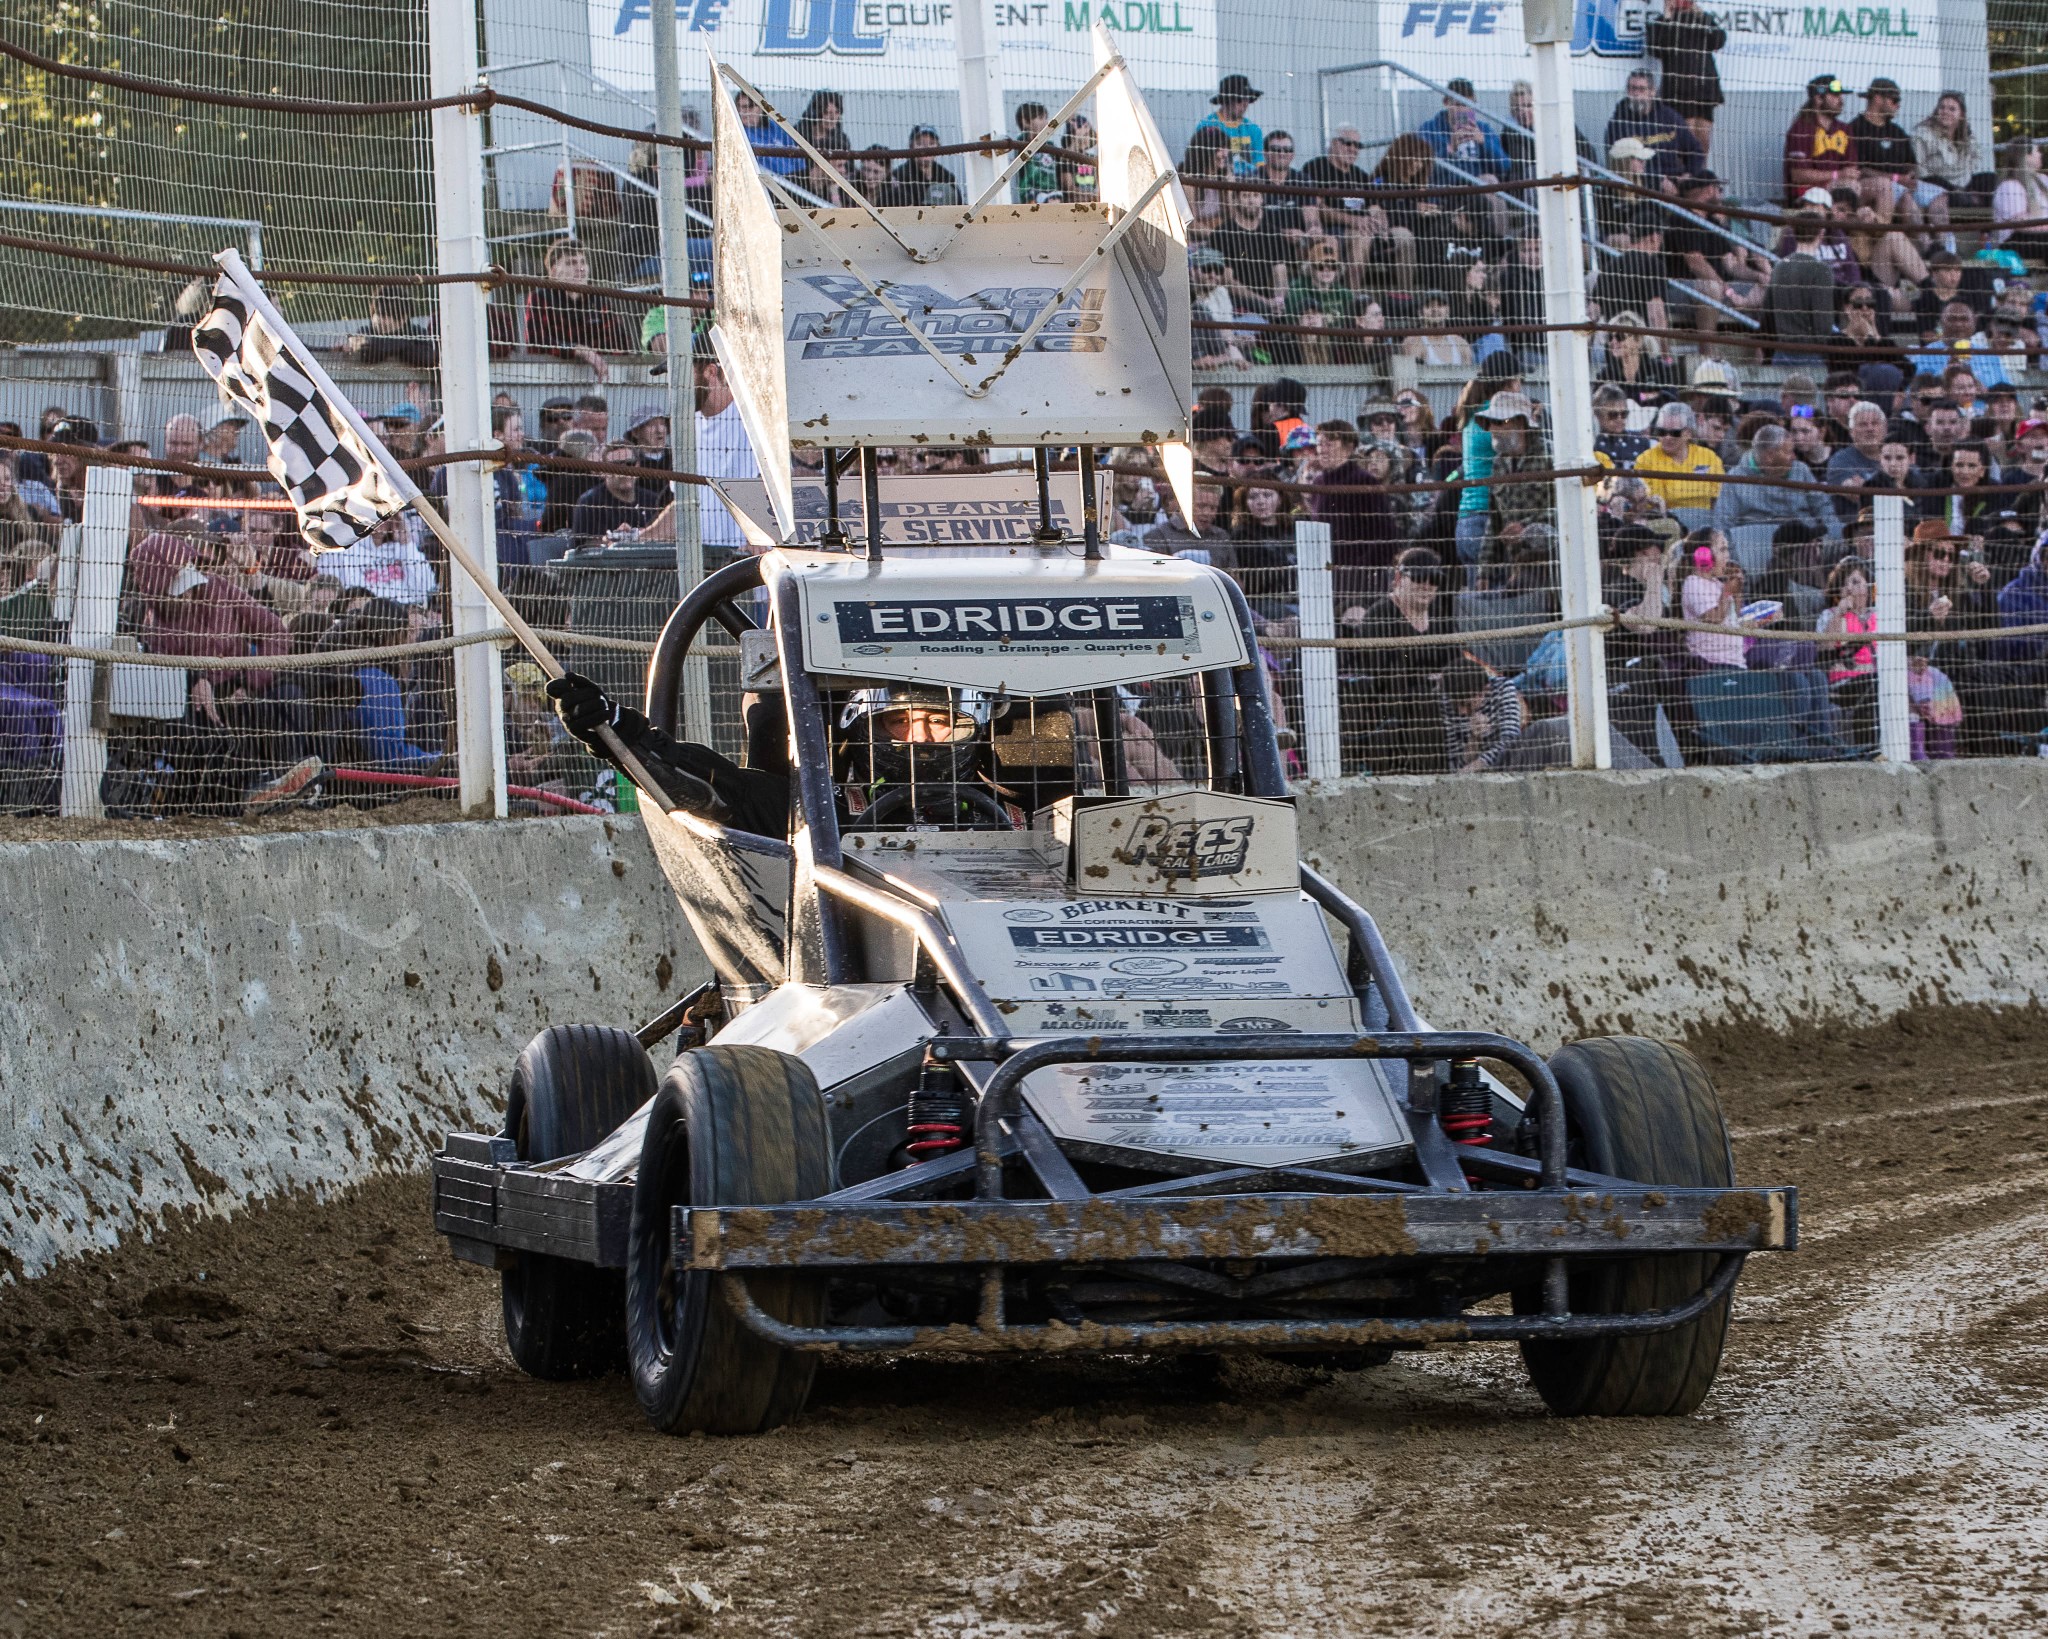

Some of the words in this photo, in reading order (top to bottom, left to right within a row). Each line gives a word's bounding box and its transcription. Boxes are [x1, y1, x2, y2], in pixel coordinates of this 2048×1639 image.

[864, 4, 1048, 27] EQUIPENT
[1064, 1, 1193, 32] MADILL
[1802, 6, 1918, 37] MADILL
[821, 336, 1087, 357] RACING
[897, 501, 1041, 516] DEAN'S
[870, 603, 1144, 634] EDRIDGE
[920, 645, 984, 655] Roading
[1000, 644, 1070, 654] Drainage
[1084, 643, 1153, 652] Quarries
[1124, 815, 1254, 858] REES
[1162, 855, 1201, 869] RAC
[1203, 852, 1240, 867] CARS
[1060, 900, 1190, 920] BERKETT
[1033, 930, 1232, 945] EDRIDGE
[1040, 1020, 1129, 1030] MACHINE
[1234, 1021, 1277, 1030] TMT
[1116, 1065, 1196, 1074] NIGEL
[1205, 1065, 1313, 1073] BRYANT
